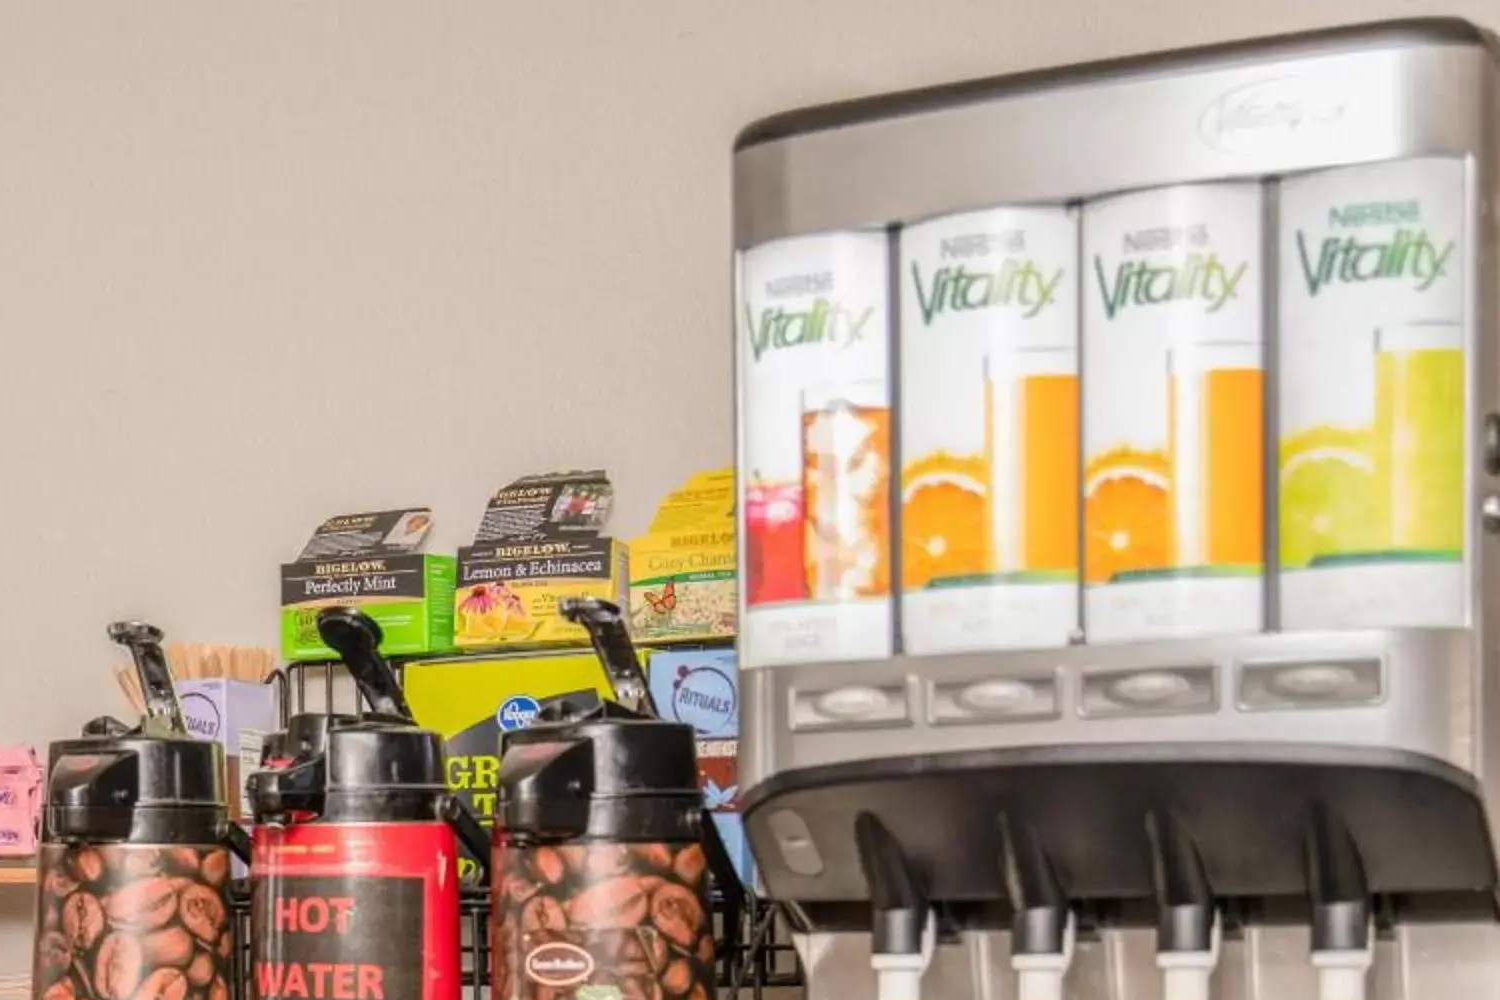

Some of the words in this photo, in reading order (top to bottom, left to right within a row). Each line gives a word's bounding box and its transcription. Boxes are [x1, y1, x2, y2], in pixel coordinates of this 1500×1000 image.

[1296, 228, 1455, 297] Vitality
[911, 258, 1064, 327] Vitality
[1095, 250, 1249, 321] Vitality
[746, 295, 875, 363] Vitality
[304, 577, 361, 595] Perfectly
[364, 575, 396, 591] Mint
[315, 560, 386, 575] BIGELOW
[463, 566, 512, 581] Lemon
[515, 563, 527, 577] &
[529, 559, 602, 576] Echinacea
[679, 688, 731, 713] RITUALS
[275, 896, 357, 934] HOT
[256, 961, 385, 1000] WATER
